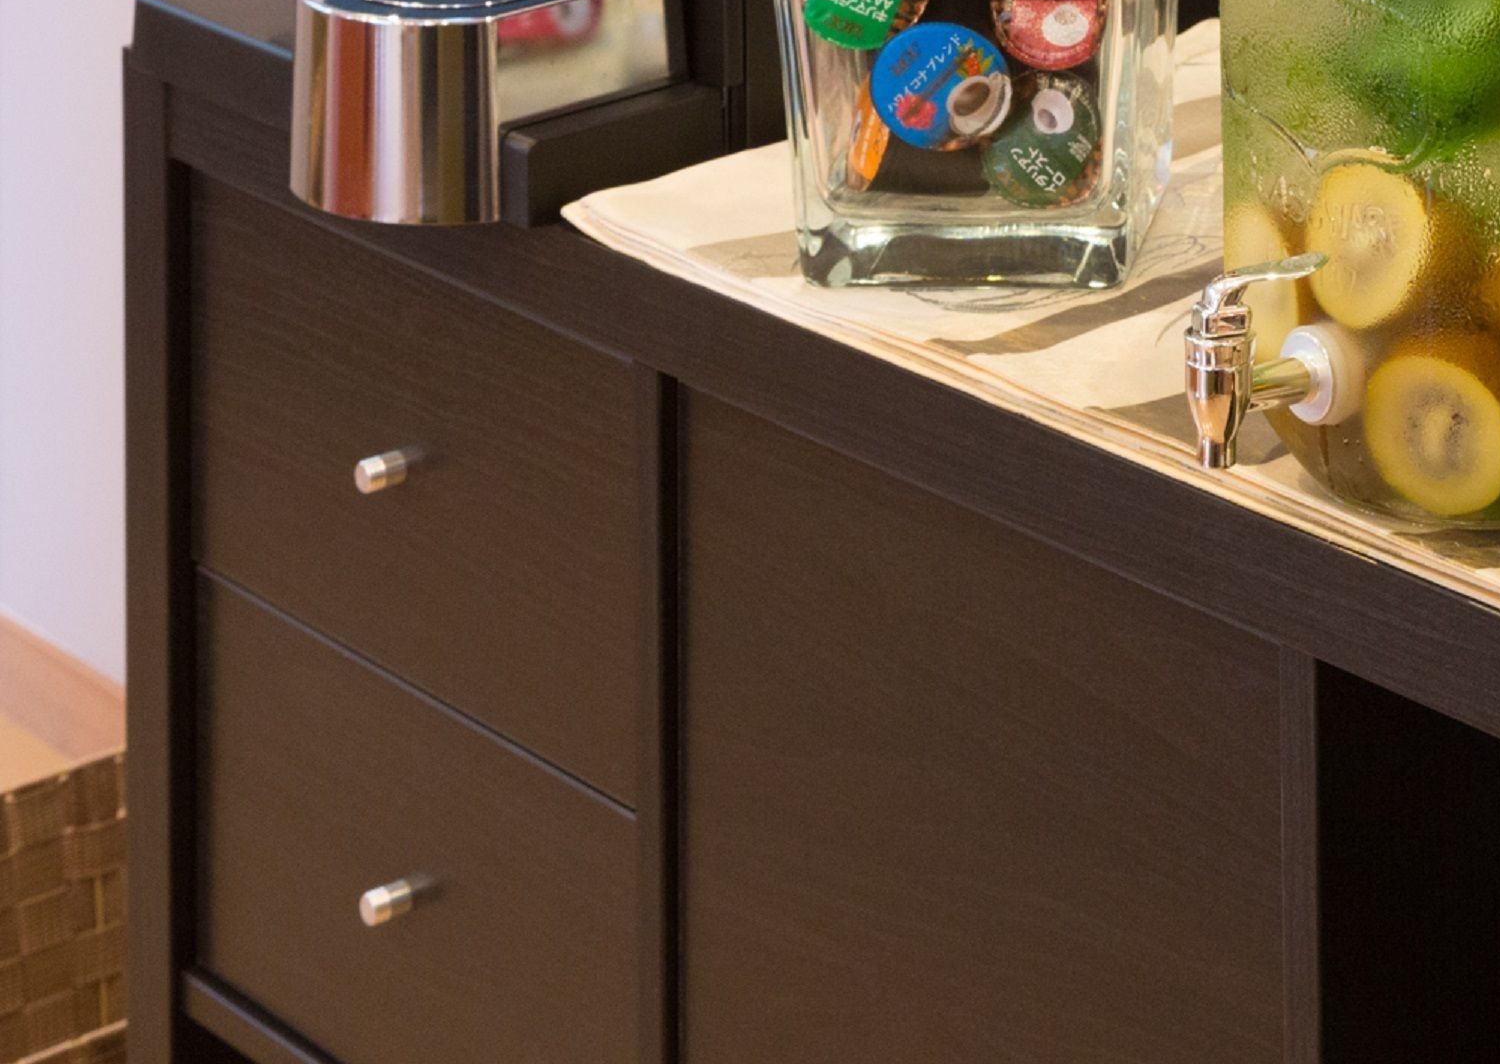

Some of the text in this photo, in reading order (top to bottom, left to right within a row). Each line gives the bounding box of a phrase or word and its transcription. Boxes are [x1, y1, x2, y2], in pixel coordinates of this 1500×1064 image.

[1009, 147, 1057, 193] イタリアン
[1027, 146, 1067, 187] ロースト
